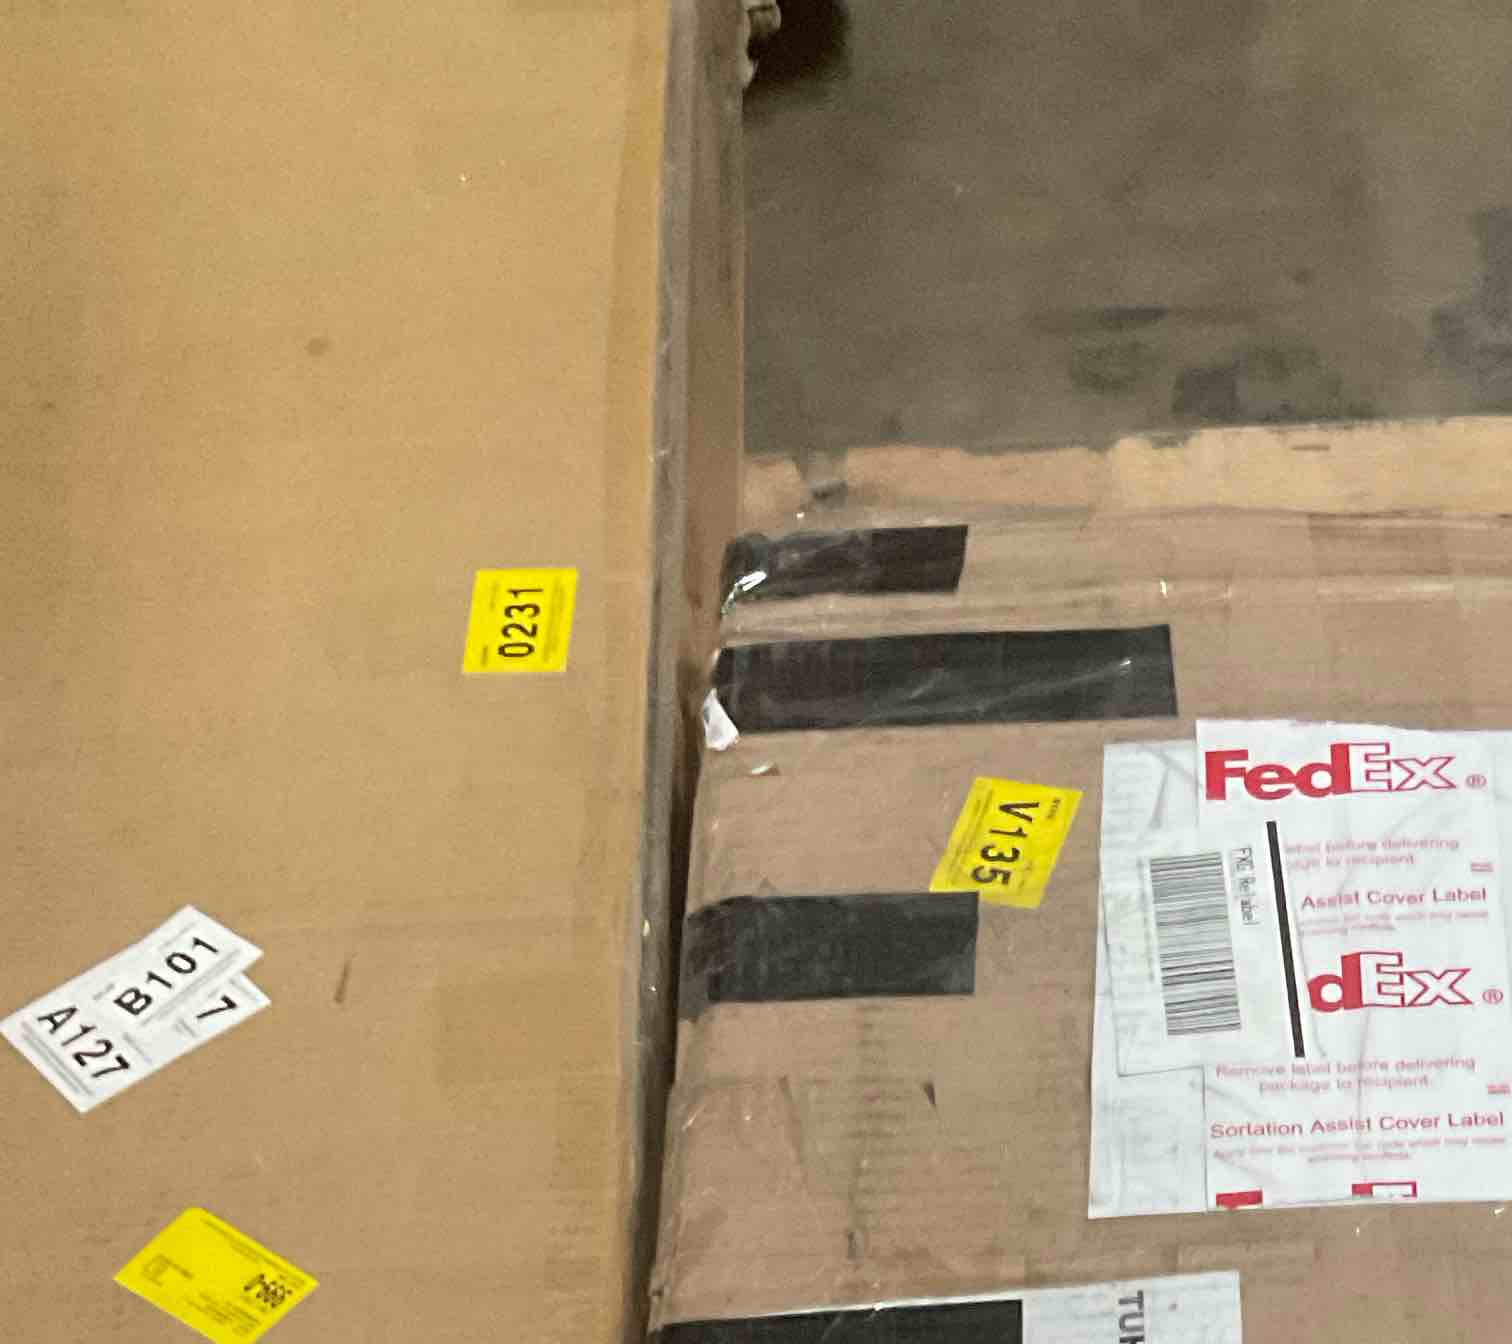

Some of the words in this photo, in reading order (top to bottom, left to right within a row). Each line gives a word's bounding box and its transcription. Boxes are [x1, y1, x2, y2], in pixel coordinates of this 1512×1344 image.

[497, 588, 544, 658] 0231
[1205, 742, 1456, 801] FedEx
[971, 801, 1040, 885] V135
[1301, 890, 1360, 911] Assist
[1367, 888, 1425, 906] Cover
[1432, 886, 1487, 903] Label
[113, 936, 218, 1017] B101
[1306, 951, 1473, 1012] dEx
[37, 1005, 130, 1079] A127
[1215, 1063, 1287, 1079] Remove
[1290, 1061, 1331, 1076] label
[1336, 1060, 1390, 1074] before
[1395, 1056, 1476, 1073] delivering
[1258, 1078, 1330, 1096] package
[1210, 1119, 1303, 1139] Sortation
[1310, 1117, 1372, 1135] Assist
[1379, 1115, 1441, 1131] Cover
[1447, 1112, 1505, 1127] Label
